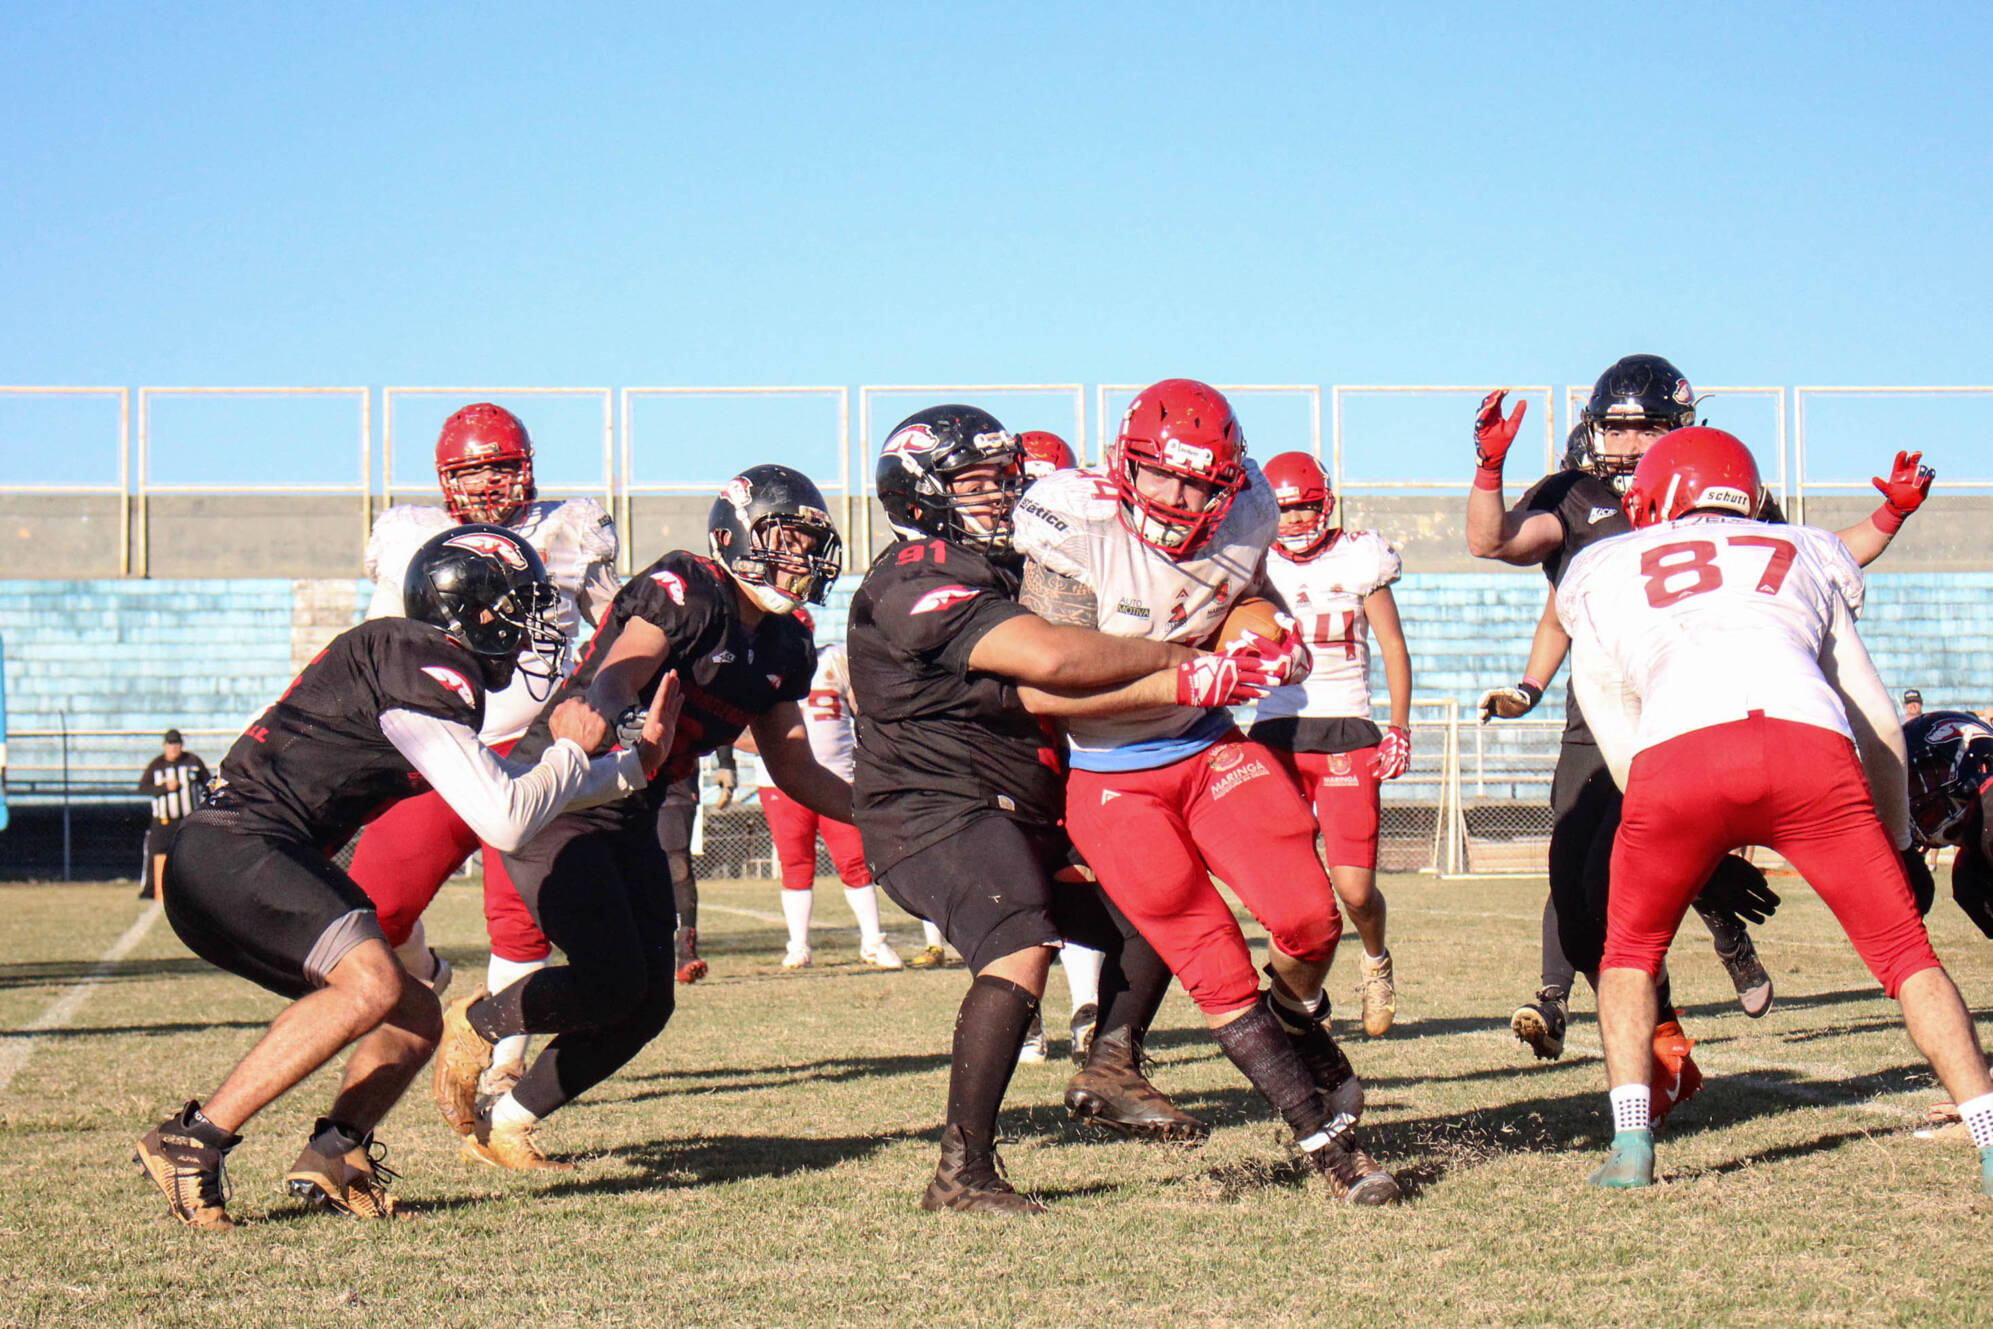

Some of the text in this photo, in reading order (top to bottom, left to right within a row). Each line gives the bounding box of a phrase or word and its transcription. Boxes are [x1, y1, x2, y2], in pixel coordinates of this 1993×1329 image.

[1707, 489, 1748, 506] schutt
[896, 539, 946, 565] 91
[1641, 535, 1798, 608] 87
[1117, 604, 1150, 617] MOTIVA
